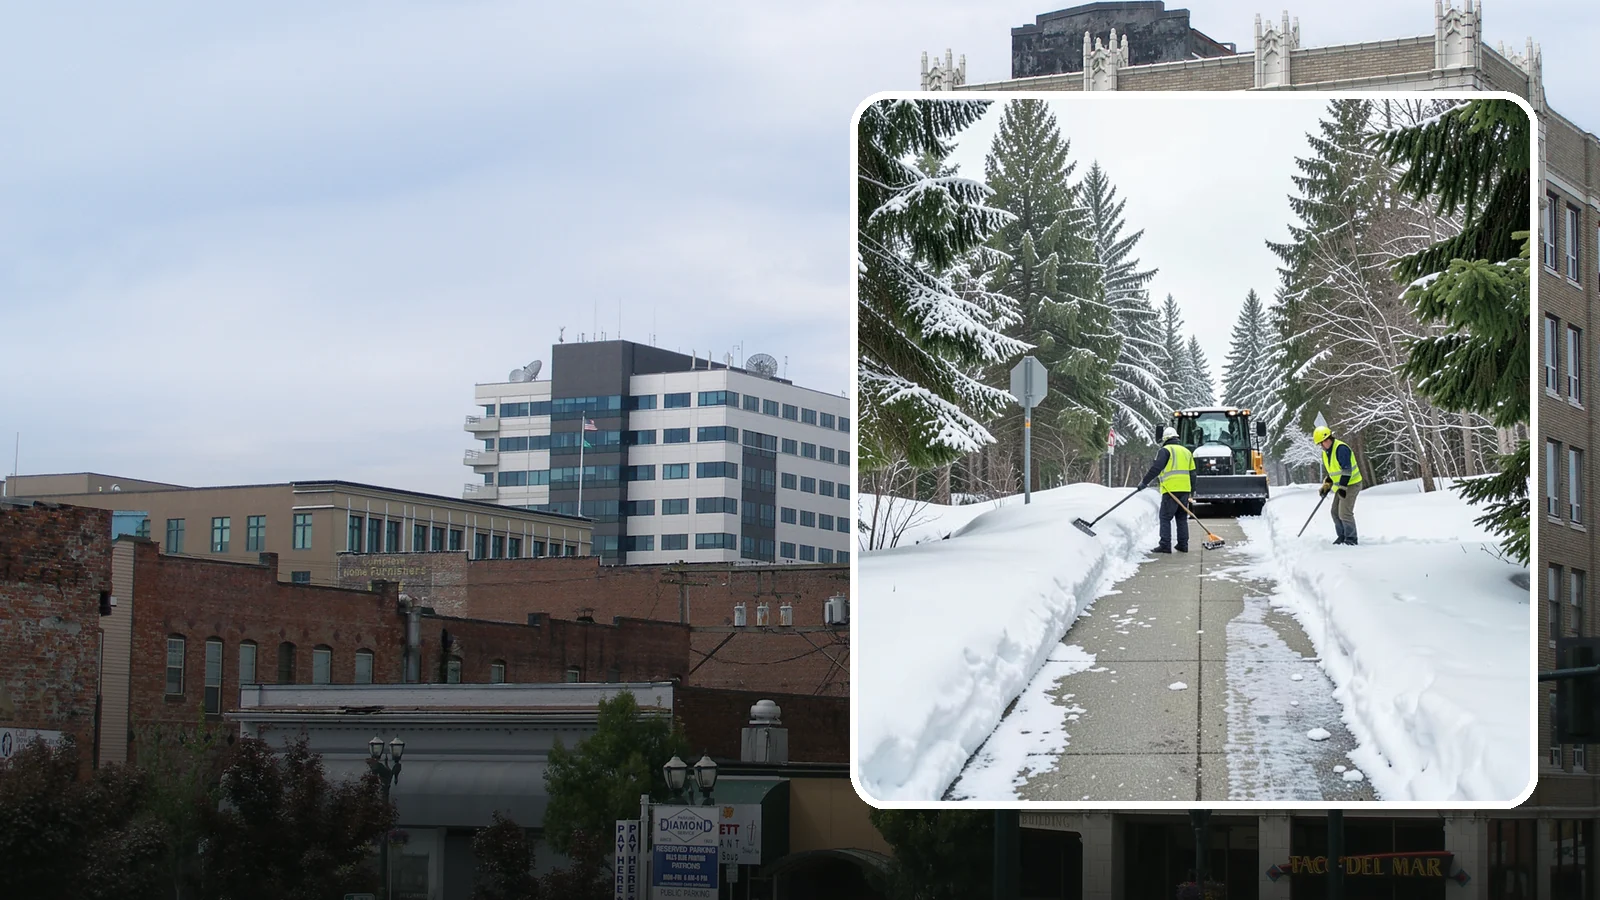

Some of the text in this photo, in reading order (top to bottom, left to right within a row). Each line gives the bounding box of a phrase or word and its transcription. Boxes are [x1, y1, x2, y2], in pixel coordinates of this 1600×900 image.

[660, 818, 713, 832] DIAMOND
[1021, 815, 1070, 828] BUILDING
[656, 845, 716, 854] RESERVED PARKING
[721, 851, 739, 862] Soup
[1289, 856, 1443, 877] TAC DEL MAR
[660, 889, 710, 898] PUBLIC PARKING
